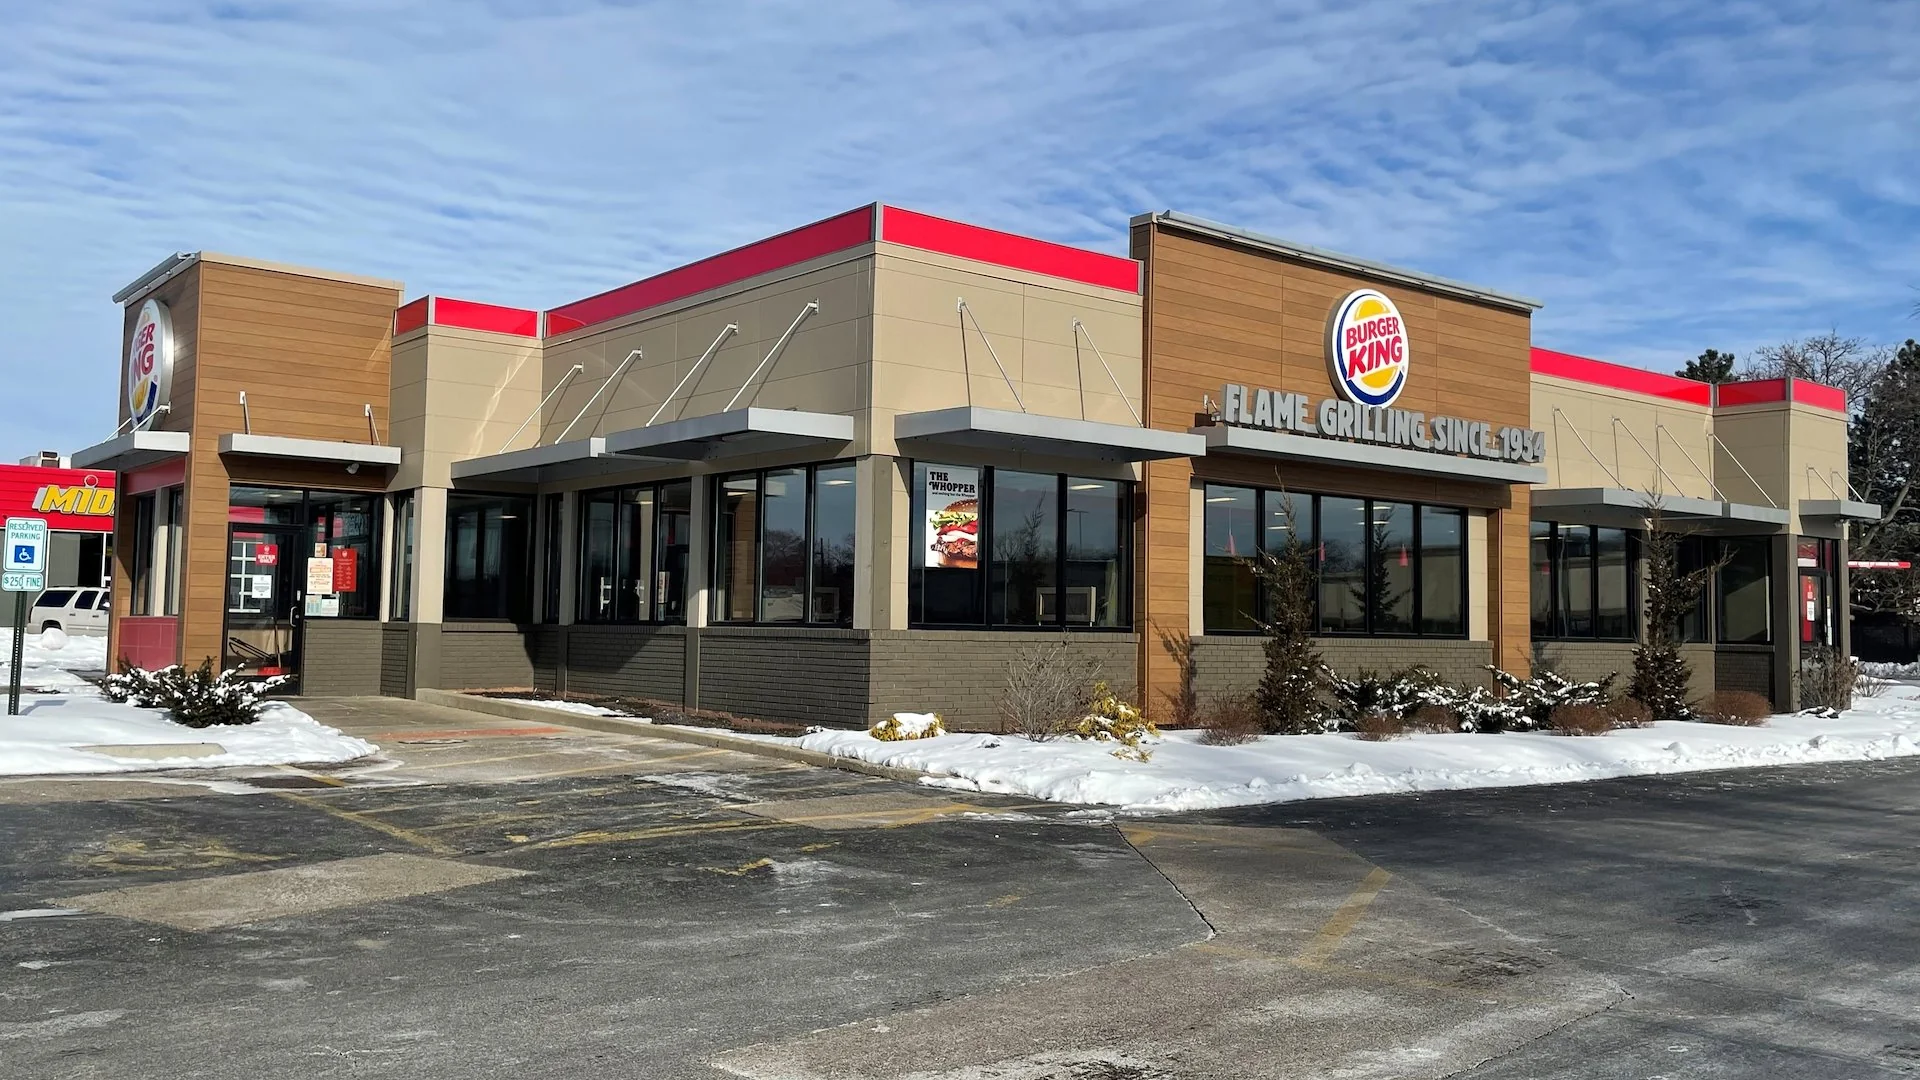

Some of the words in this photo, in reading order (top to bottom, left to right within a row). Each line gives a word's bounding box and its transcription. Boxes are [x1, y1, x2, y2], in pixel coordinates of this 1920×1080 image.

[134, 323, 155, 352] GER
[1346, 316, 1400, 349] BURGER
[132, 343, 155, 388] NG
[1348, 335, 1402, 379] KING
[1223, 383, 1310, 432] FLAME
[1318, 398, 1427, 449] GRILLING
[1431, 415, 1492, 458] SINCE
[1498, 426, 1546, 464] 1954
[928, 481, 976, 494] WHOPPER
[929, 471, 949, 482] THE
[38, 475, 116, 515] MID
[9, 522, 44, 532] RESERVED
[11, 532, 41, 540] PARKING
[4, 576, 24, 587] $250
[26, 576, 41, 587] FINE
